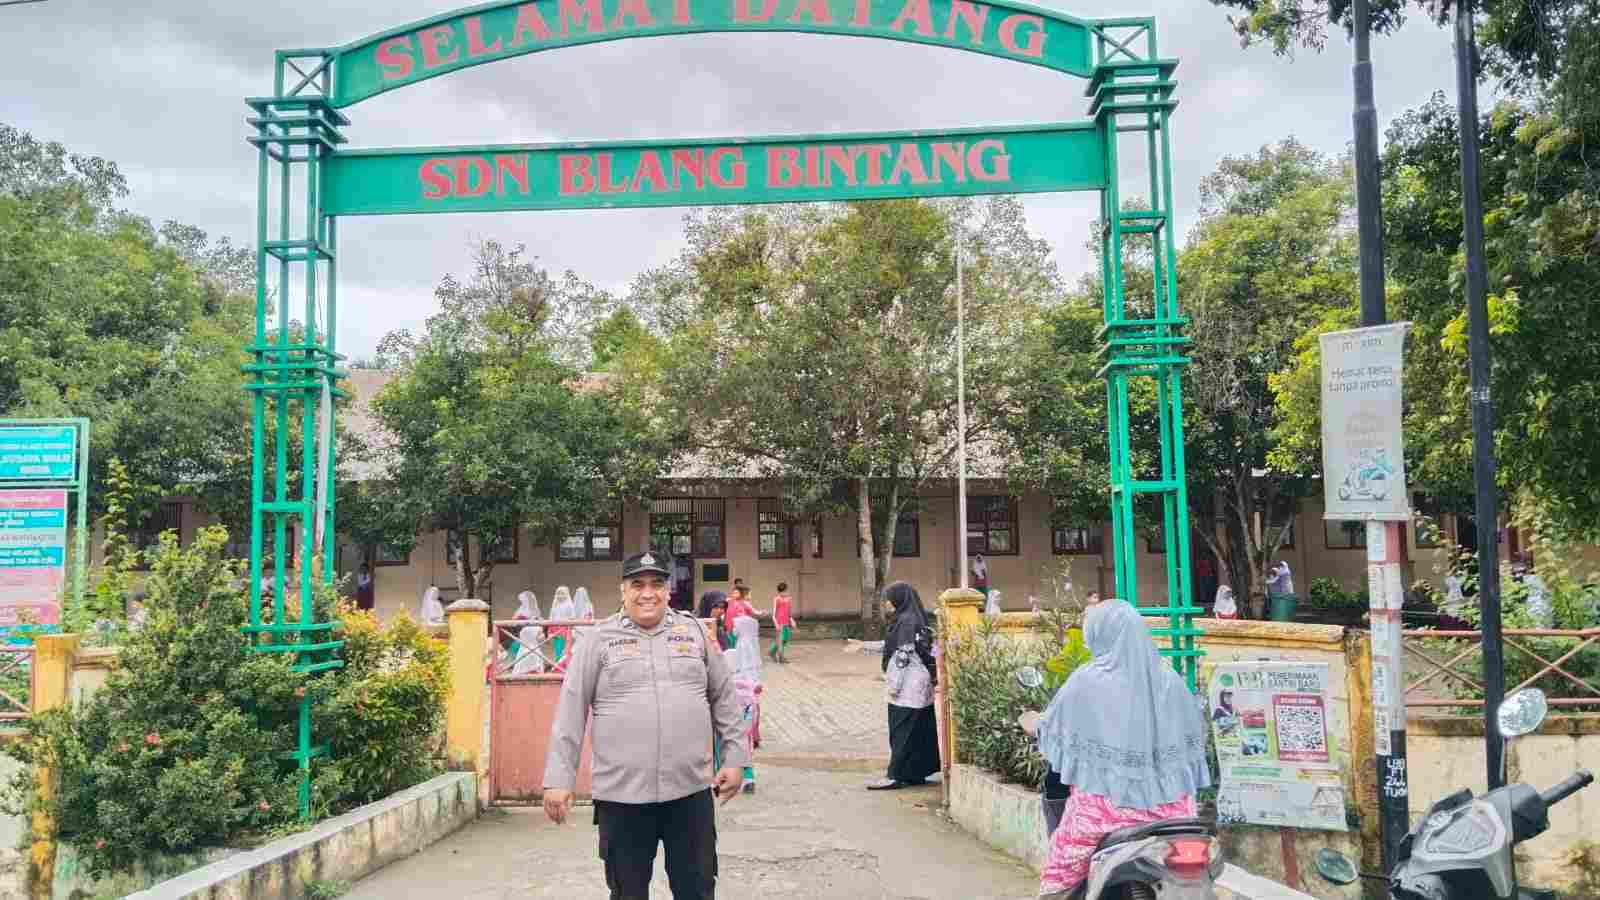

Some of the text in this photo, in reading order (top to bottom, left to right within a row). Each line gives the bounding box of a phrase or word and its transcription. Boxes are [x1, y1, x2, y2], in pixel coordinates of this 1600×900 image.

[418, 138, 1012, 199] SDN BLANG BINTANG
